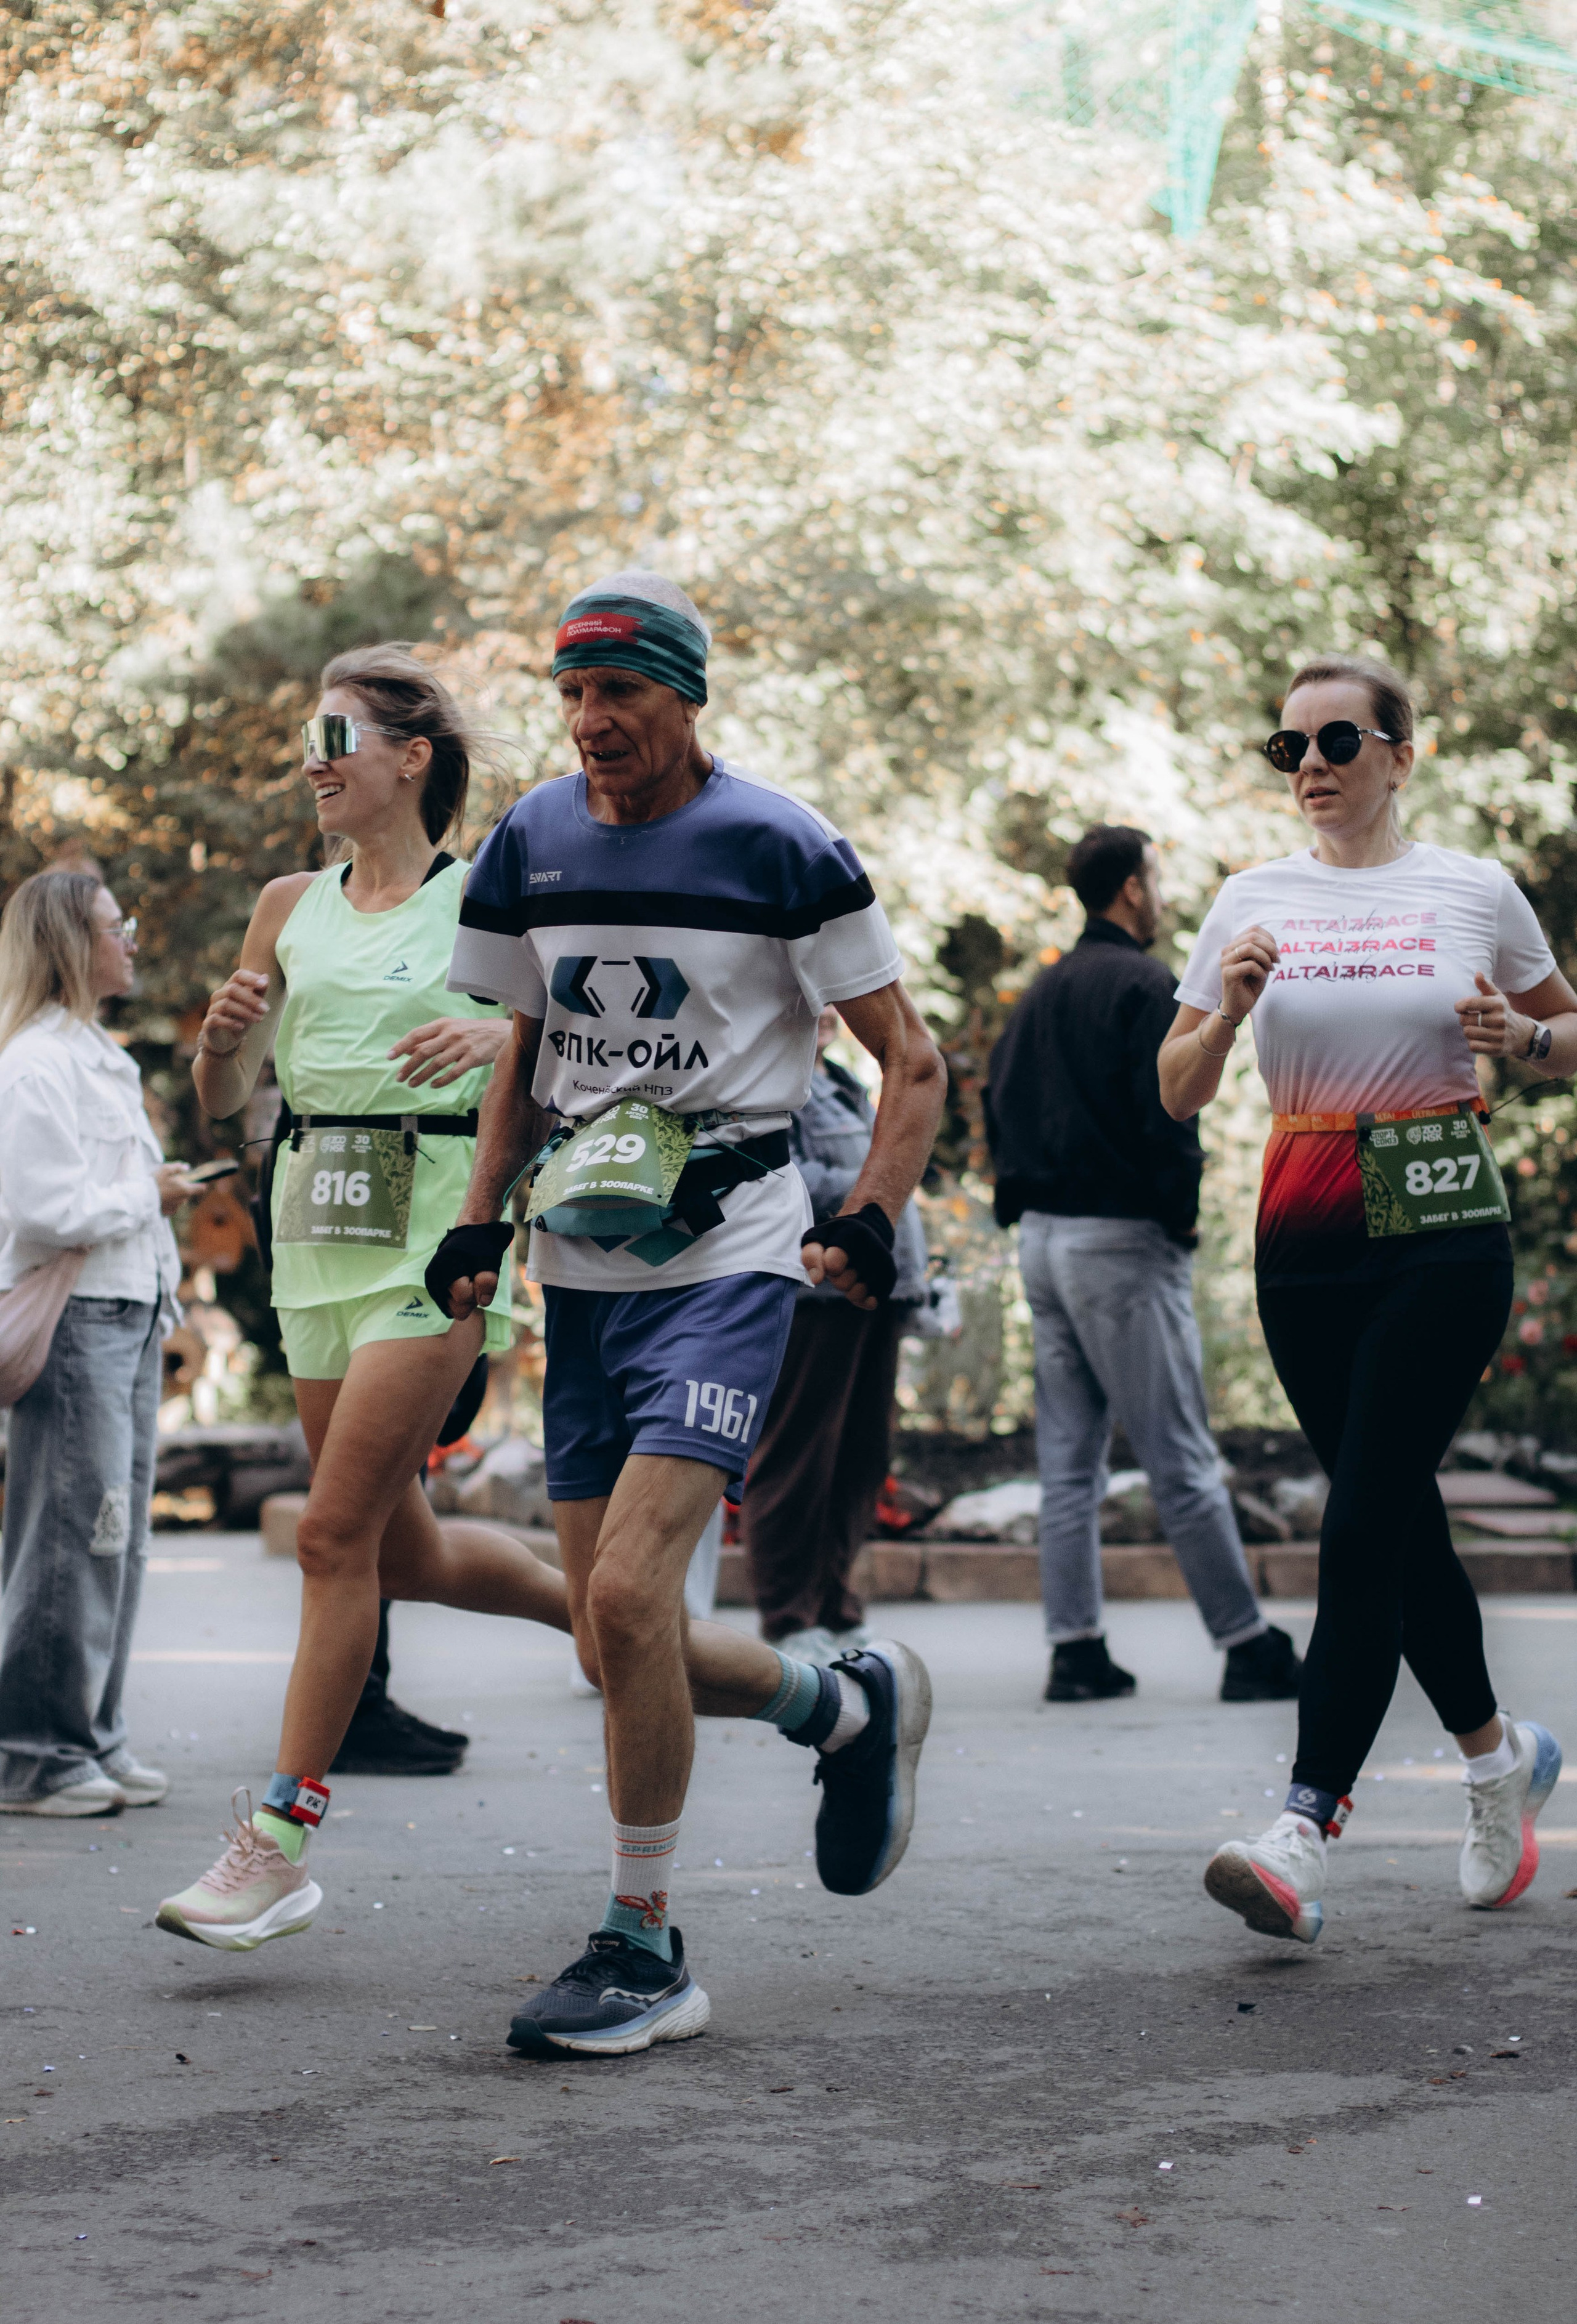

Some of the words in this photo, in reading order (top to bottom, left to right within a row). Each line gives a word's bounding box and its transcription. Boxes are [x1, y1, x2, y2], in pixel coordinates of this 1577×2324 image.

[567, 627, 622, 637] ПОЛУМАРАФОН
[529, 871, 562, 883] SVART
[548, 1030, 708, 1071] ВПК-ОЙЛ
[573, 1080, 640, 1094] Коченёский
[644, 1084, 673, 1096] НПЗ
[631, 1103, 649, 1114] 30
[1422, 1124, 1442, 1135] ZOO
[1453, 1120, 1467, 1130] 30
[354, 1135, 370, 1144] 30
[566, 1133, 646, 1173] 529
[1405, 1154, 1480, 1196] 827
[311, 1170, 370, 1207] 816
[590, 1181, 598, 1189] В
[599, 1180, 654, 1195] ЗООПАРКЕ
[1419, 1212, 1449, 1225] ЗАБЕГ
[1451, 1211, 1459, 1221] В
[1461, 1205, 1502, 1219] ЗООПАРКЕ
[684, 1380, 758, 1444] 1961
